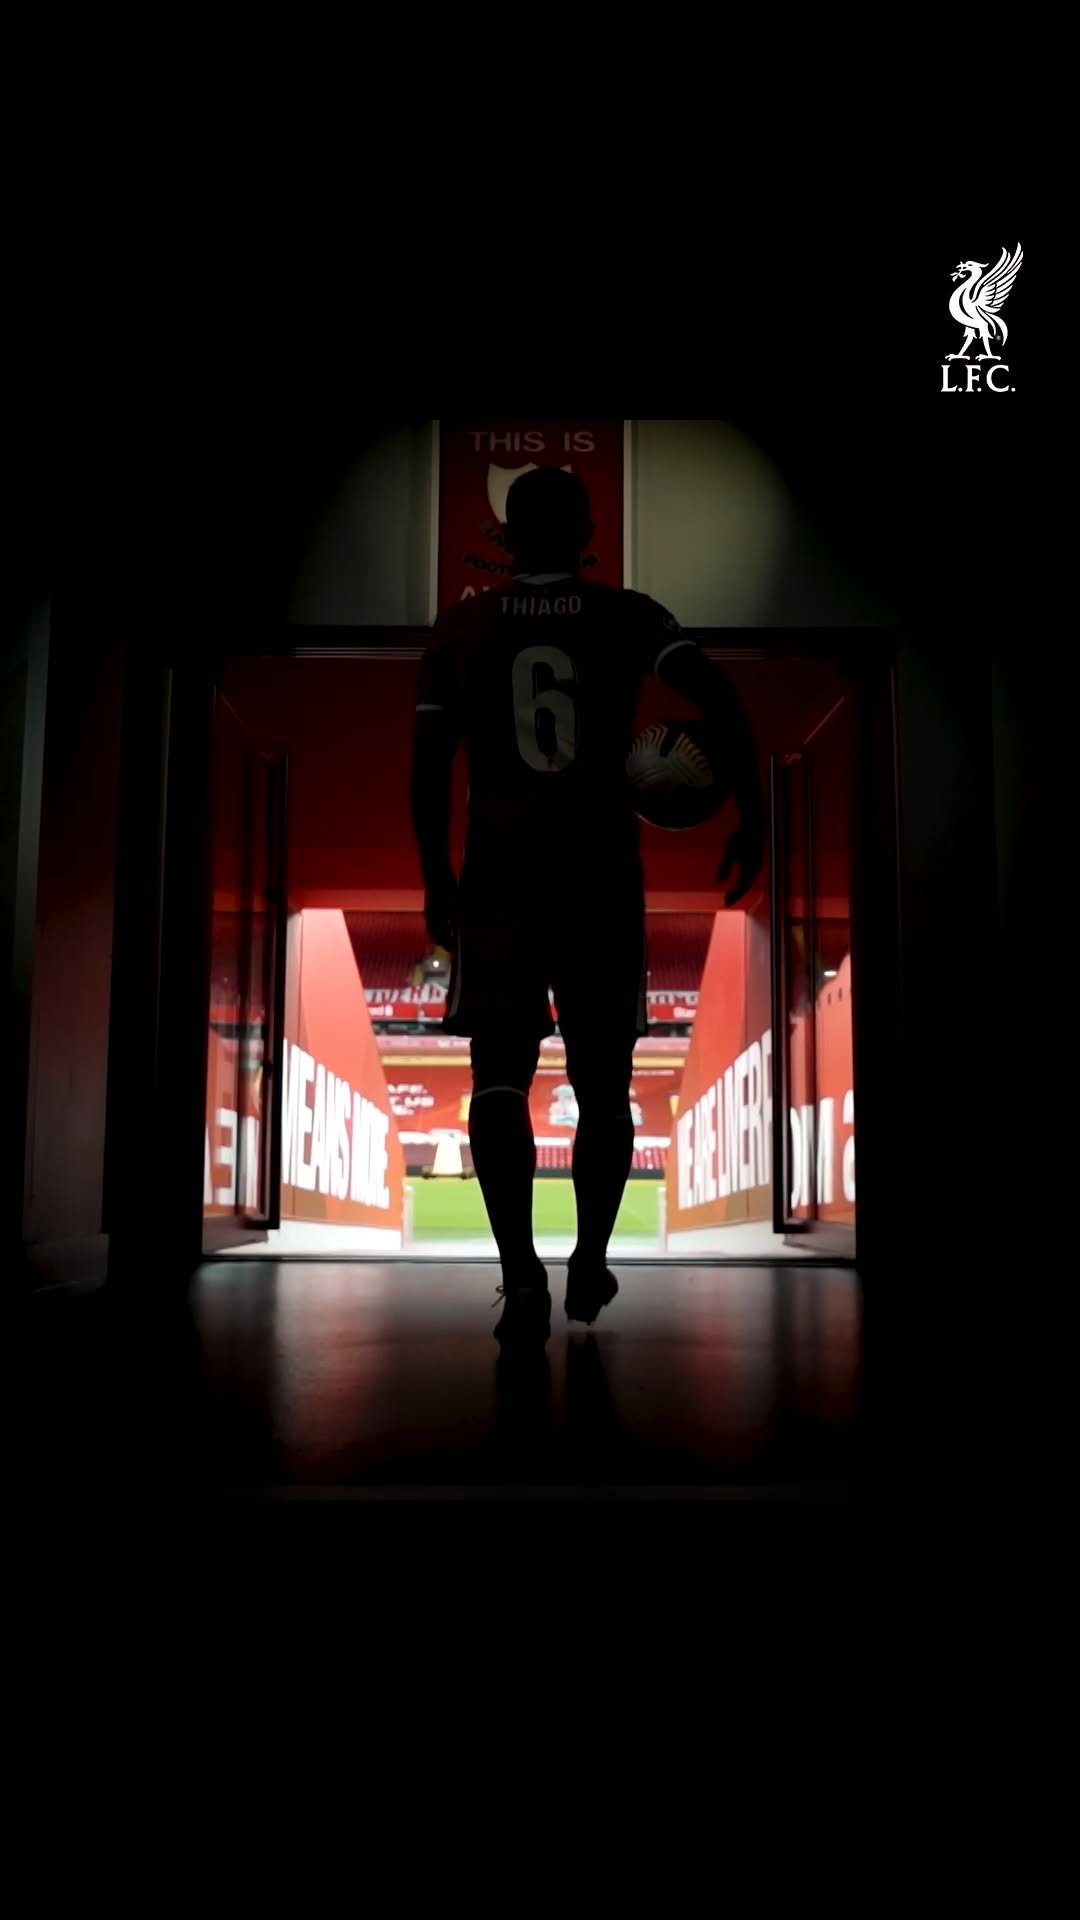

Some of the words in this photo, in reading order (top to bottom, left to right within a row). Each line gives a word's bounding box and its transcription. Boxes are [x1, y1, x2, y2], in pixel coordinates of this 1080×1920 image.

[467, 431, 546, 453] THIS
[563, 431, 597, 453] IS
[500, 595, 582, 617] THIAGO
[511, 644, 576, 774] 6
[282, 1037, 351, 1200] MEANS
